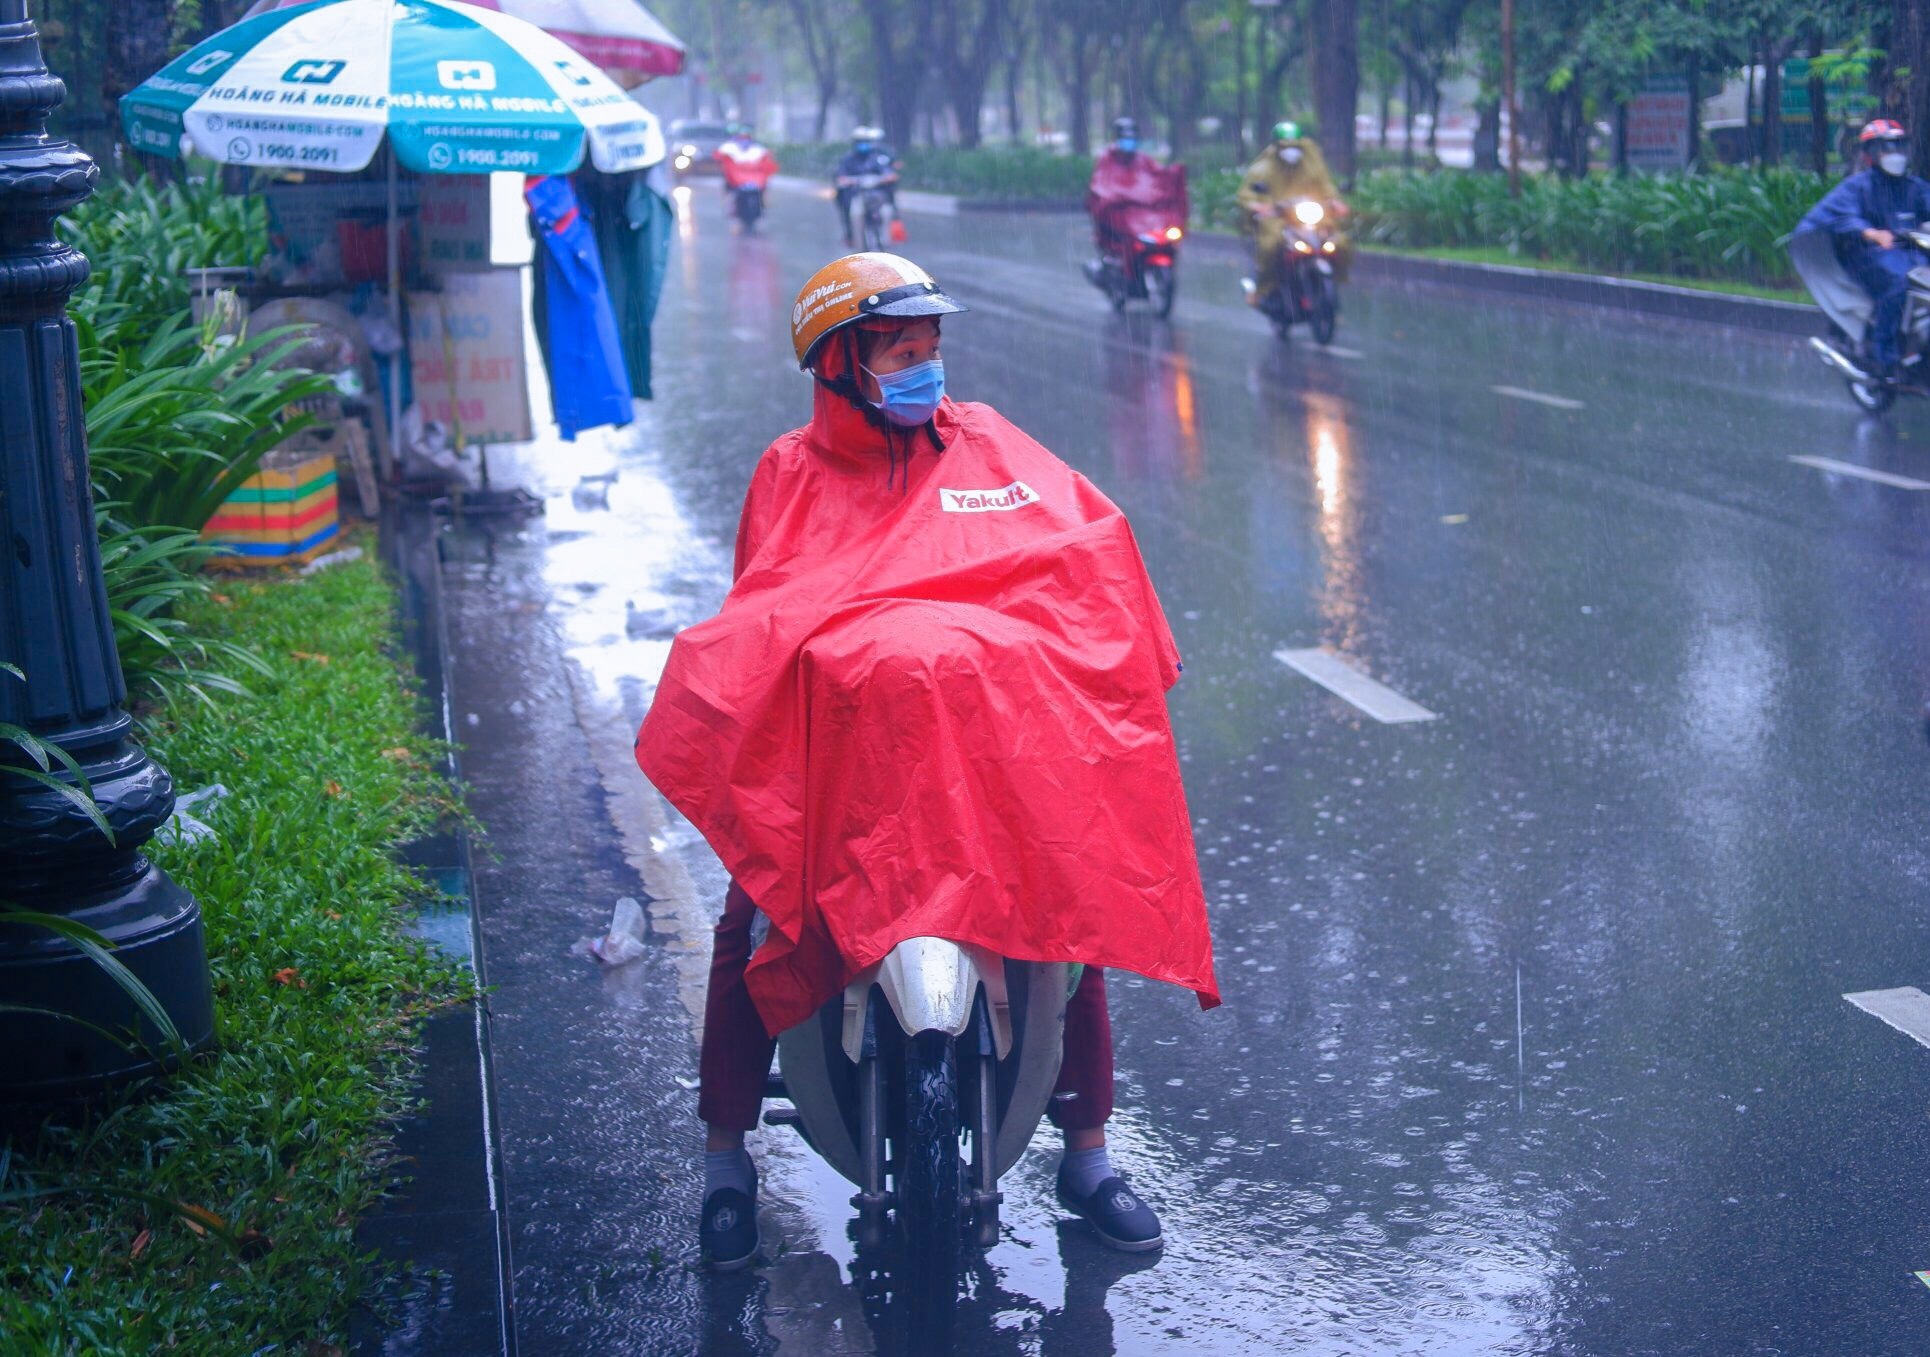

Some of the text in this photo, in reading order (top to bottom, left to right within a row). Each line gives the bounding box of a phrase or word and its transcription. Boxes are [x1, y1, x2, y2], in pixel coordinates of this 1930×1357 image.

[312, 93, 387, 110] MOBILE
[492, 97, 566, 114] MOBILE
[256, 142, 338, 163] 1900.2091
[458, 149, 538, 167] 1900.2091
[950, 486, 1030, 509] Yakult
